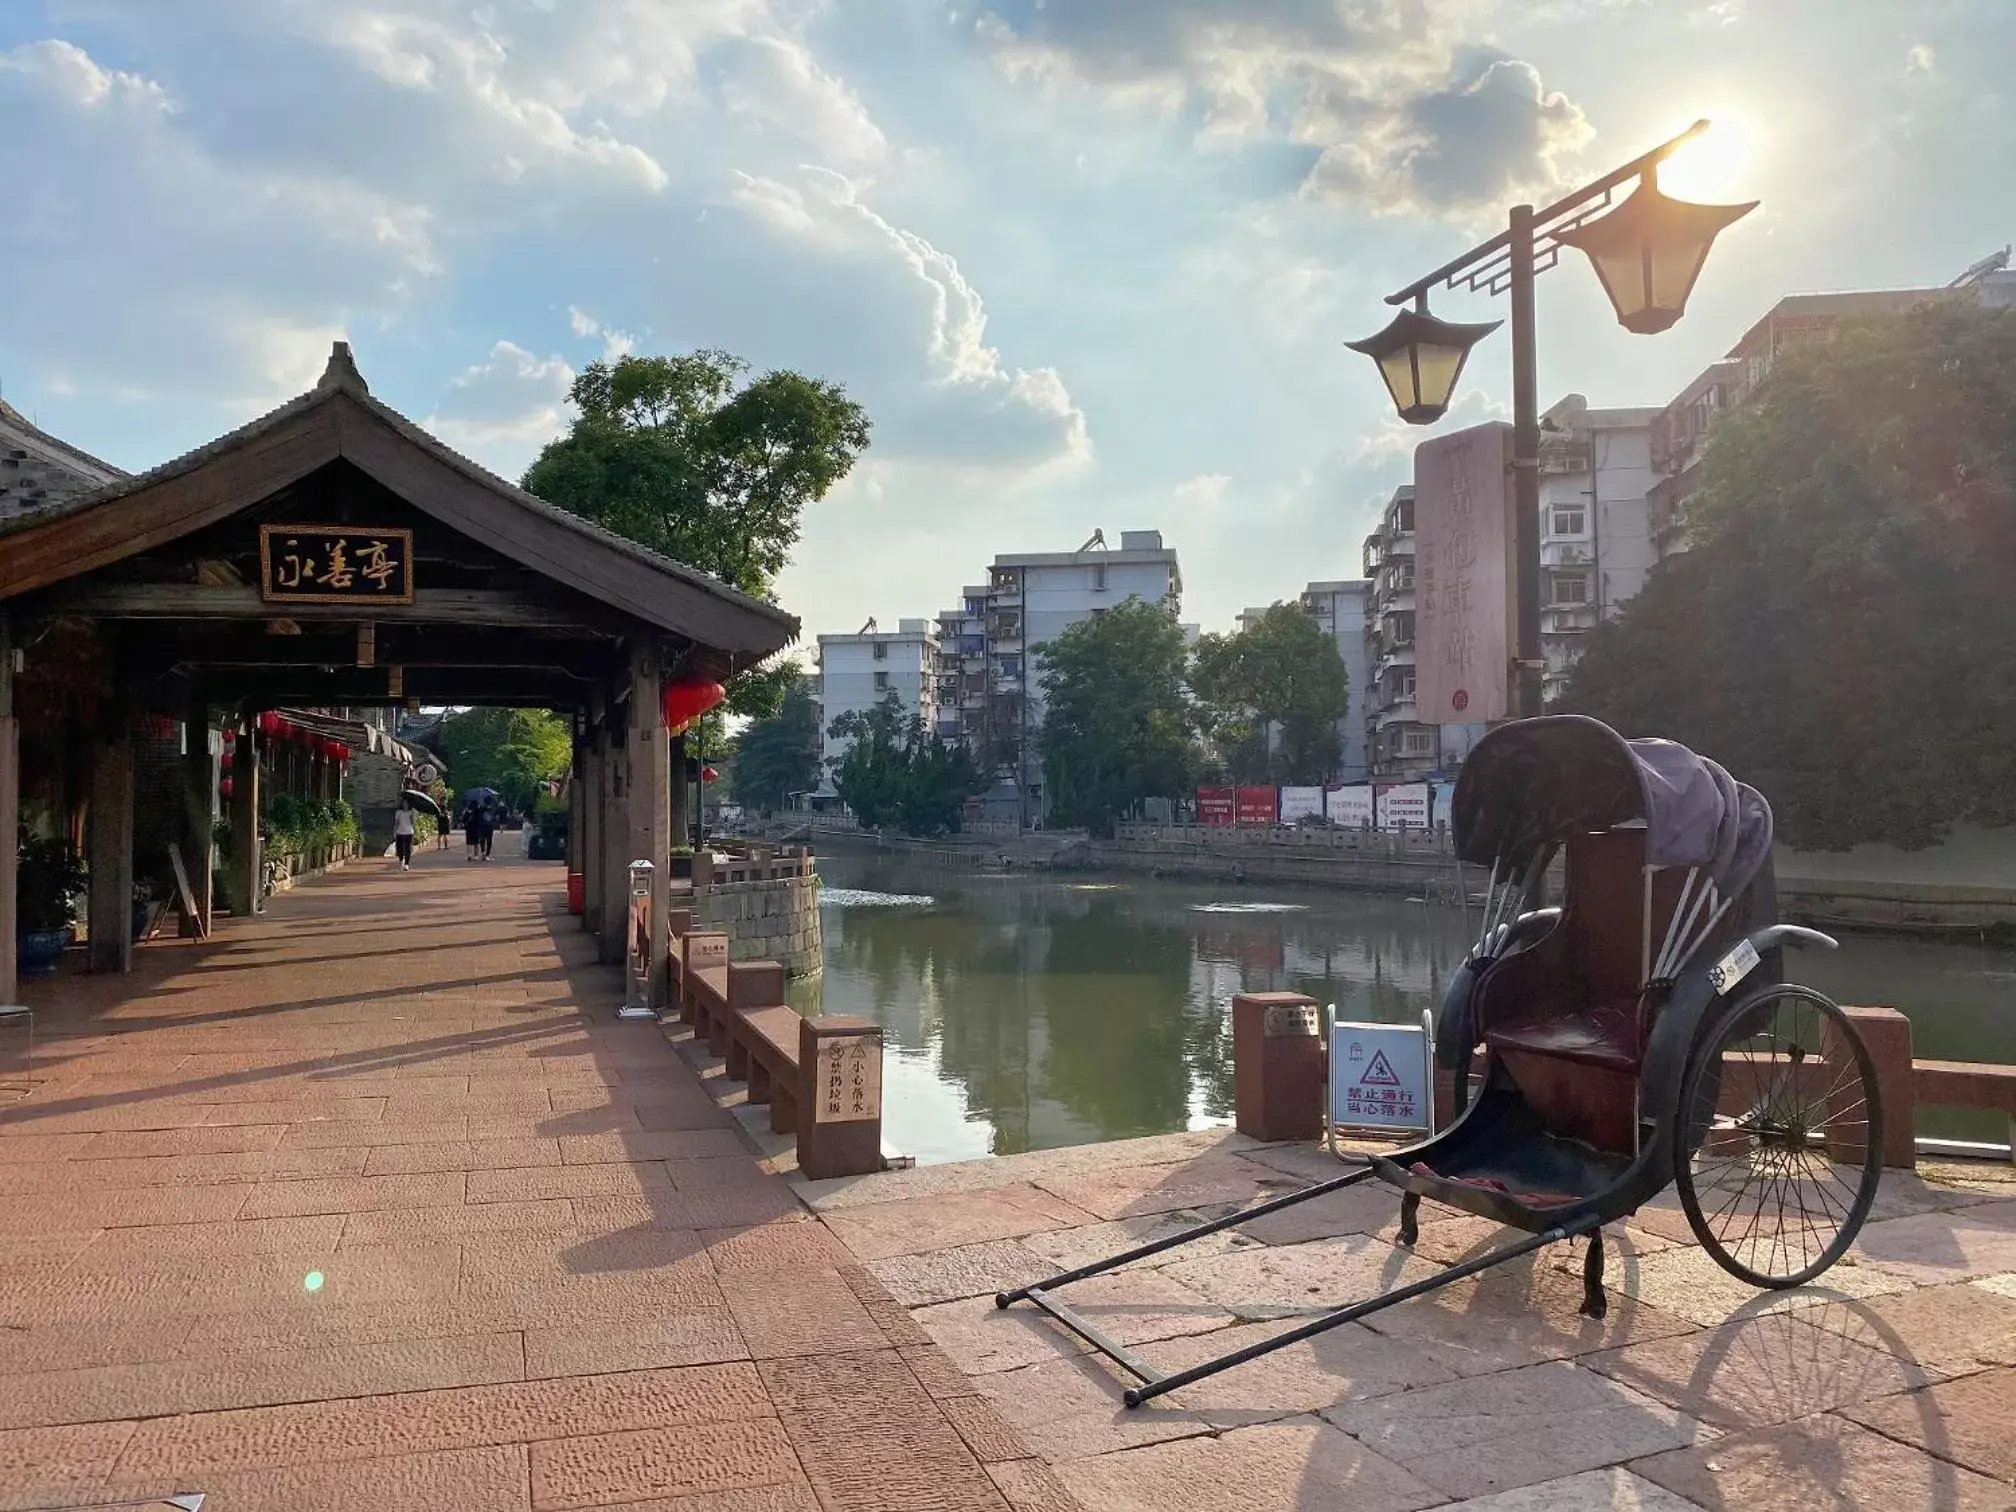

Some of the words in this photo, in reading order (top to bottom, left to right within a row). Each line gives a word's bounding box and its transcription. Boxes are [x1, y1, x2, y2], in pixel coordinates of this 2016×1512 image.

[278, 539, 398, 590] 永善亭
[851, 1061, 865, 1114] 小心落水
[1348, 1087, 1415, 1102] 禁止通行
[1348, 1102, 1414, 1117] 当心落水
